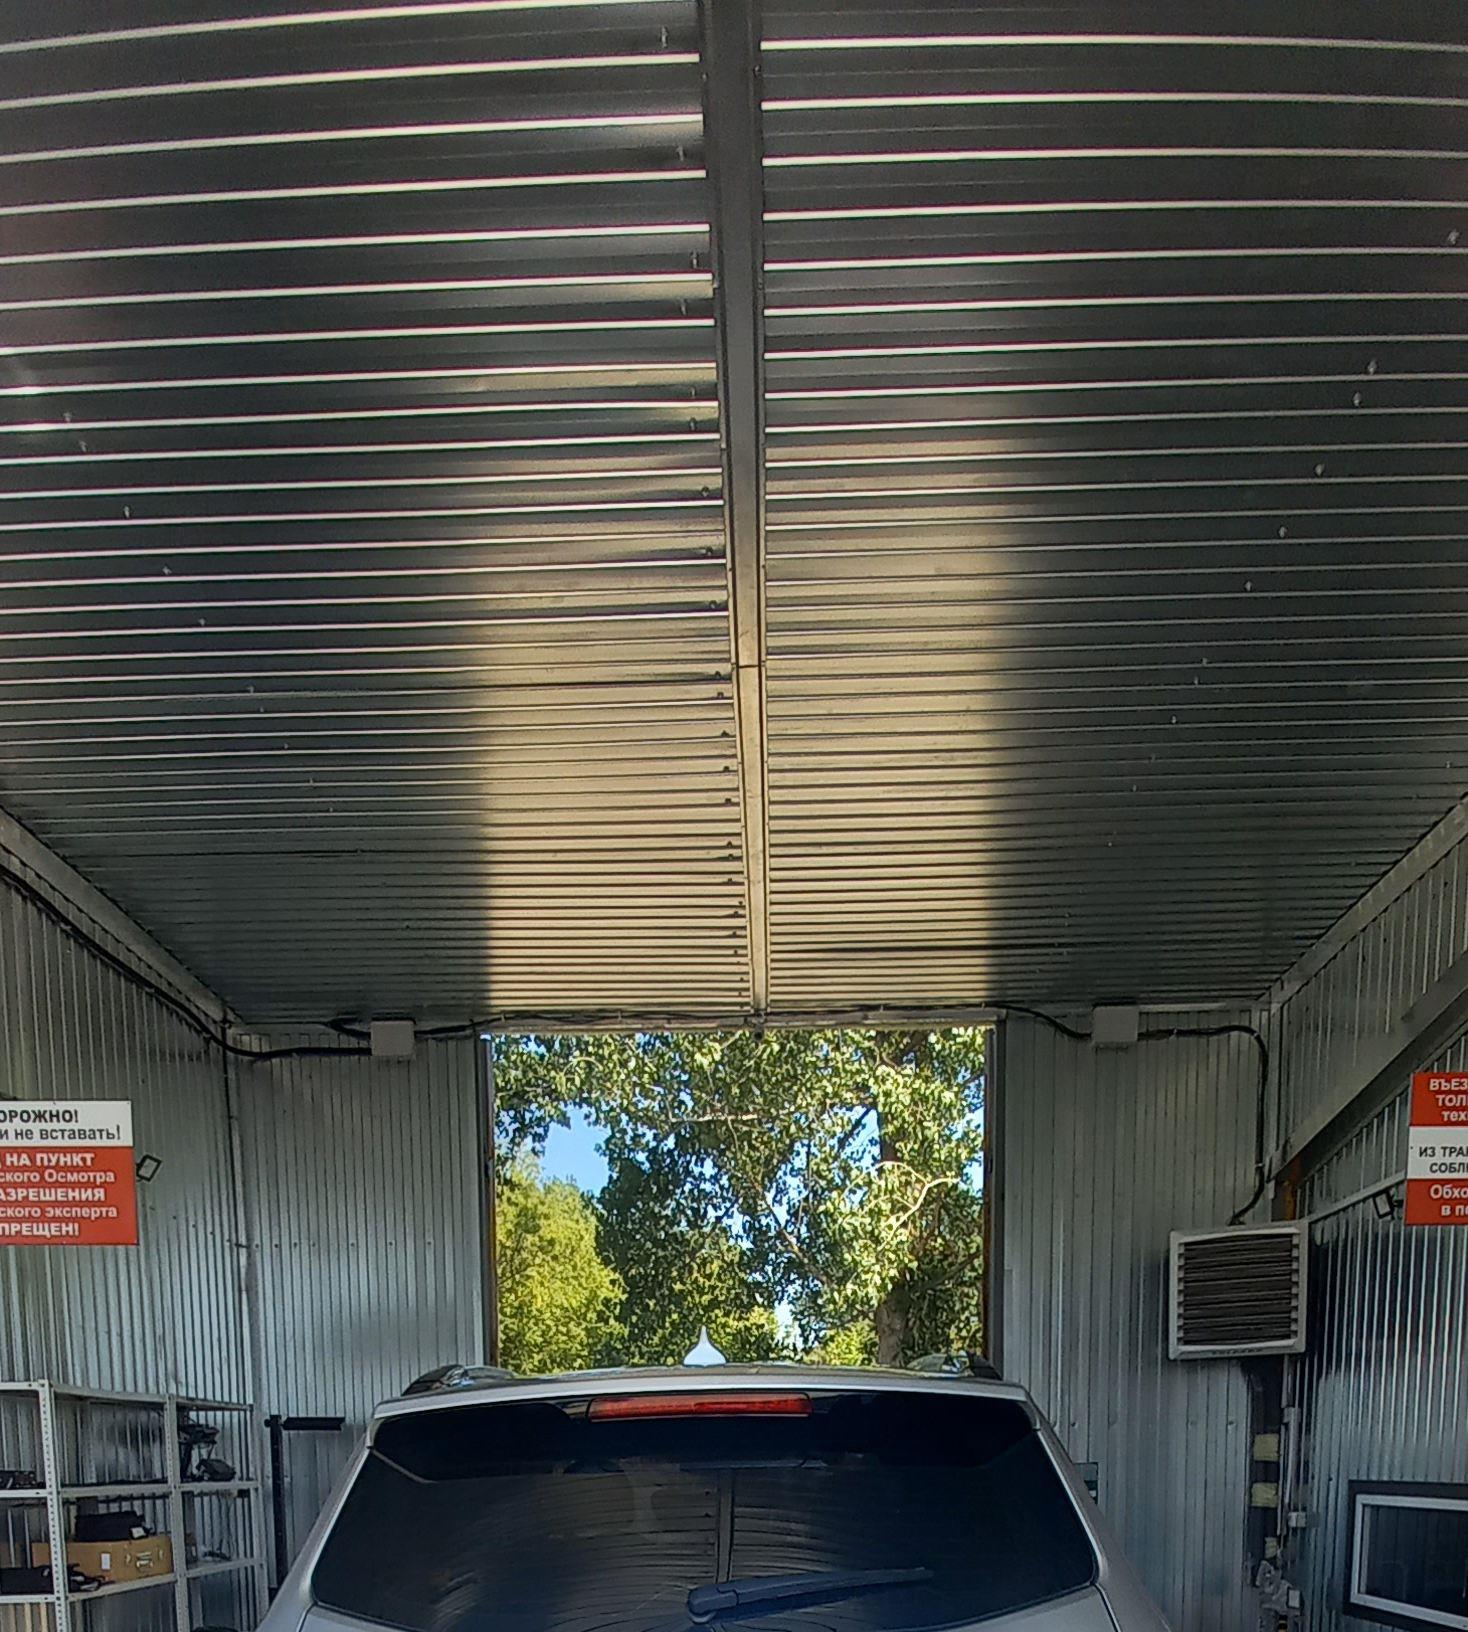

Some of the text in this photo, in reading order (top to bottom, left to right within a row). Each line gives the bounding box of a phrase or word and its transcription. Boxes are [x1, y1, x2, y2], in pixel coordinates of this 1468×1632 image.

[1435, 1094, 1468, 1107] ТОЛ
[1441, 1111, 1468, 1122] тех
[14, 1128, 34, 1140] не
[40, 1125, 121, 1140] вставать!
[1418, 1146, 1468, 1158] ИЗ ТРА
[5, 1152, 95, 1167] НА ПУНКТ
[1429, 1162, 1468, 1174] СОБЛ
[44, 1169, 115, 1185] Осмотра
[45, 1206, 117, 1220] эксперта
[1441, 1205, 1451, 1216] в
